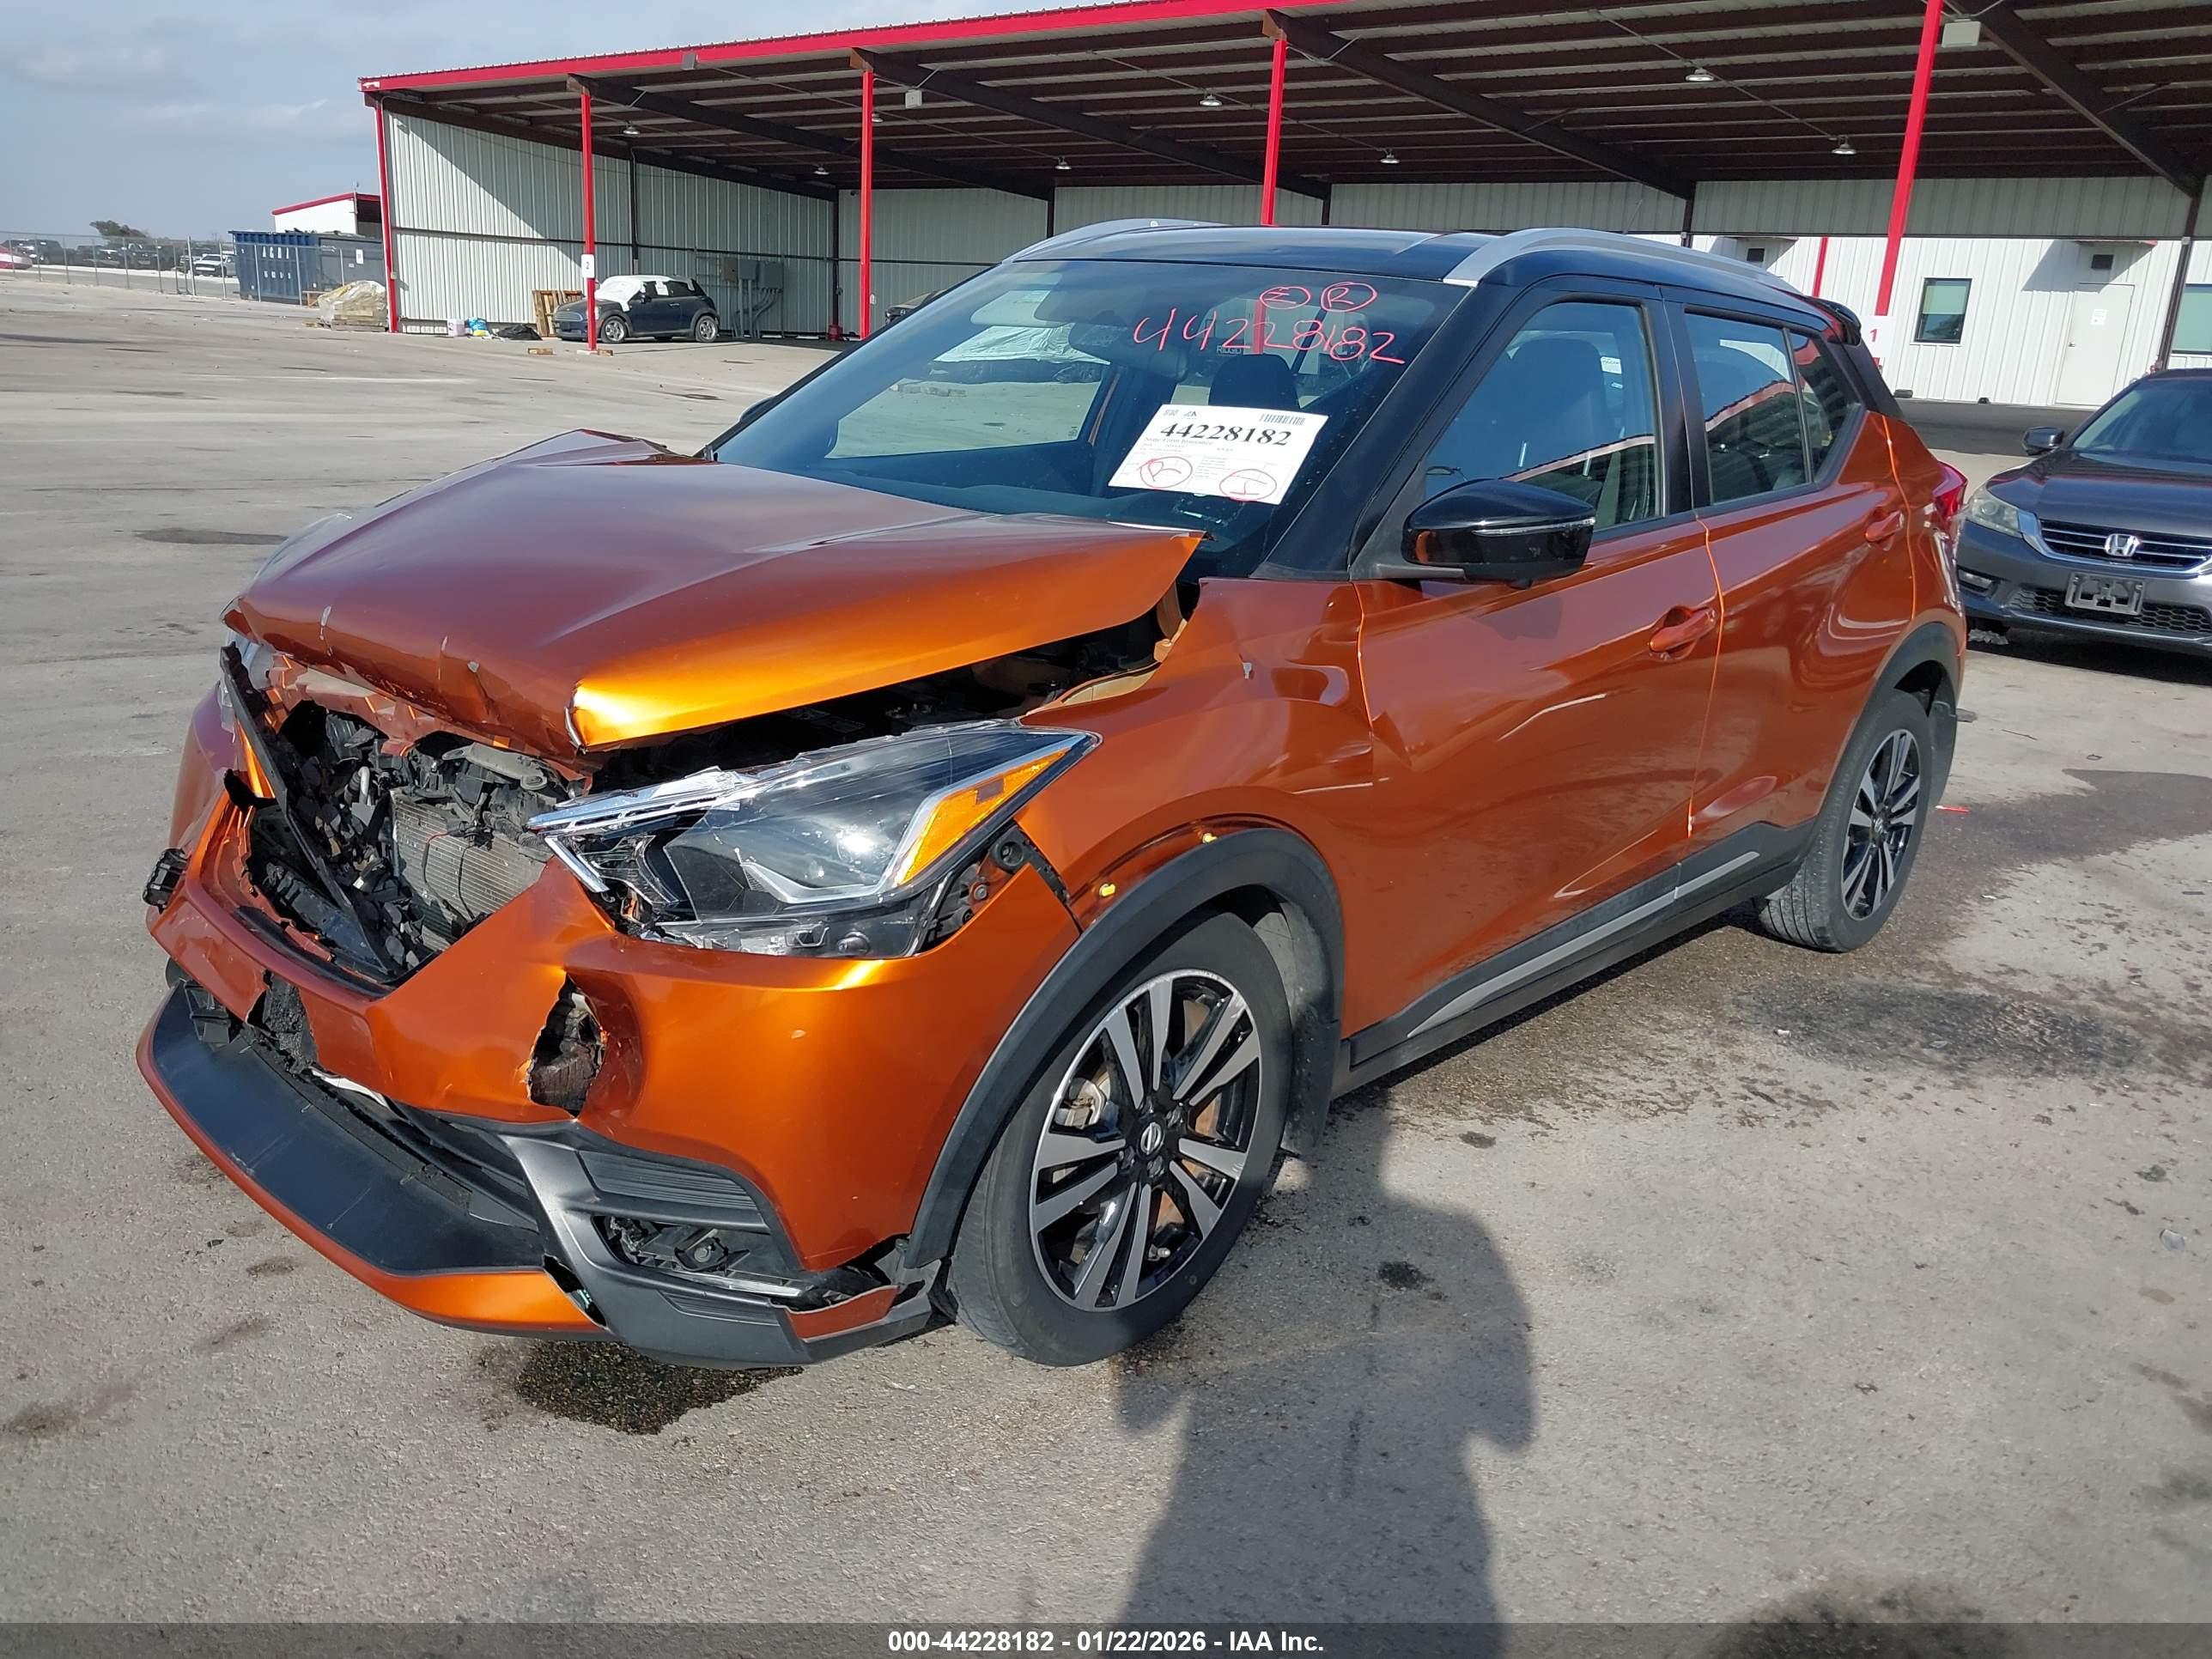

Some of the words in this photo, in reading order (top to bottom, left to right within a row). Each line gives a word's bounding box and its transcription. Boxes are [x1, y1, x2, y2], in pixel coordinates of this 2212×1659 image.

[585, 261, 591, 270] 2
[1133, 307, 1406, 364] 44228182
[1869, 328, 1878, 343] 1
[1160, 422, 1291, 447] 44228182
